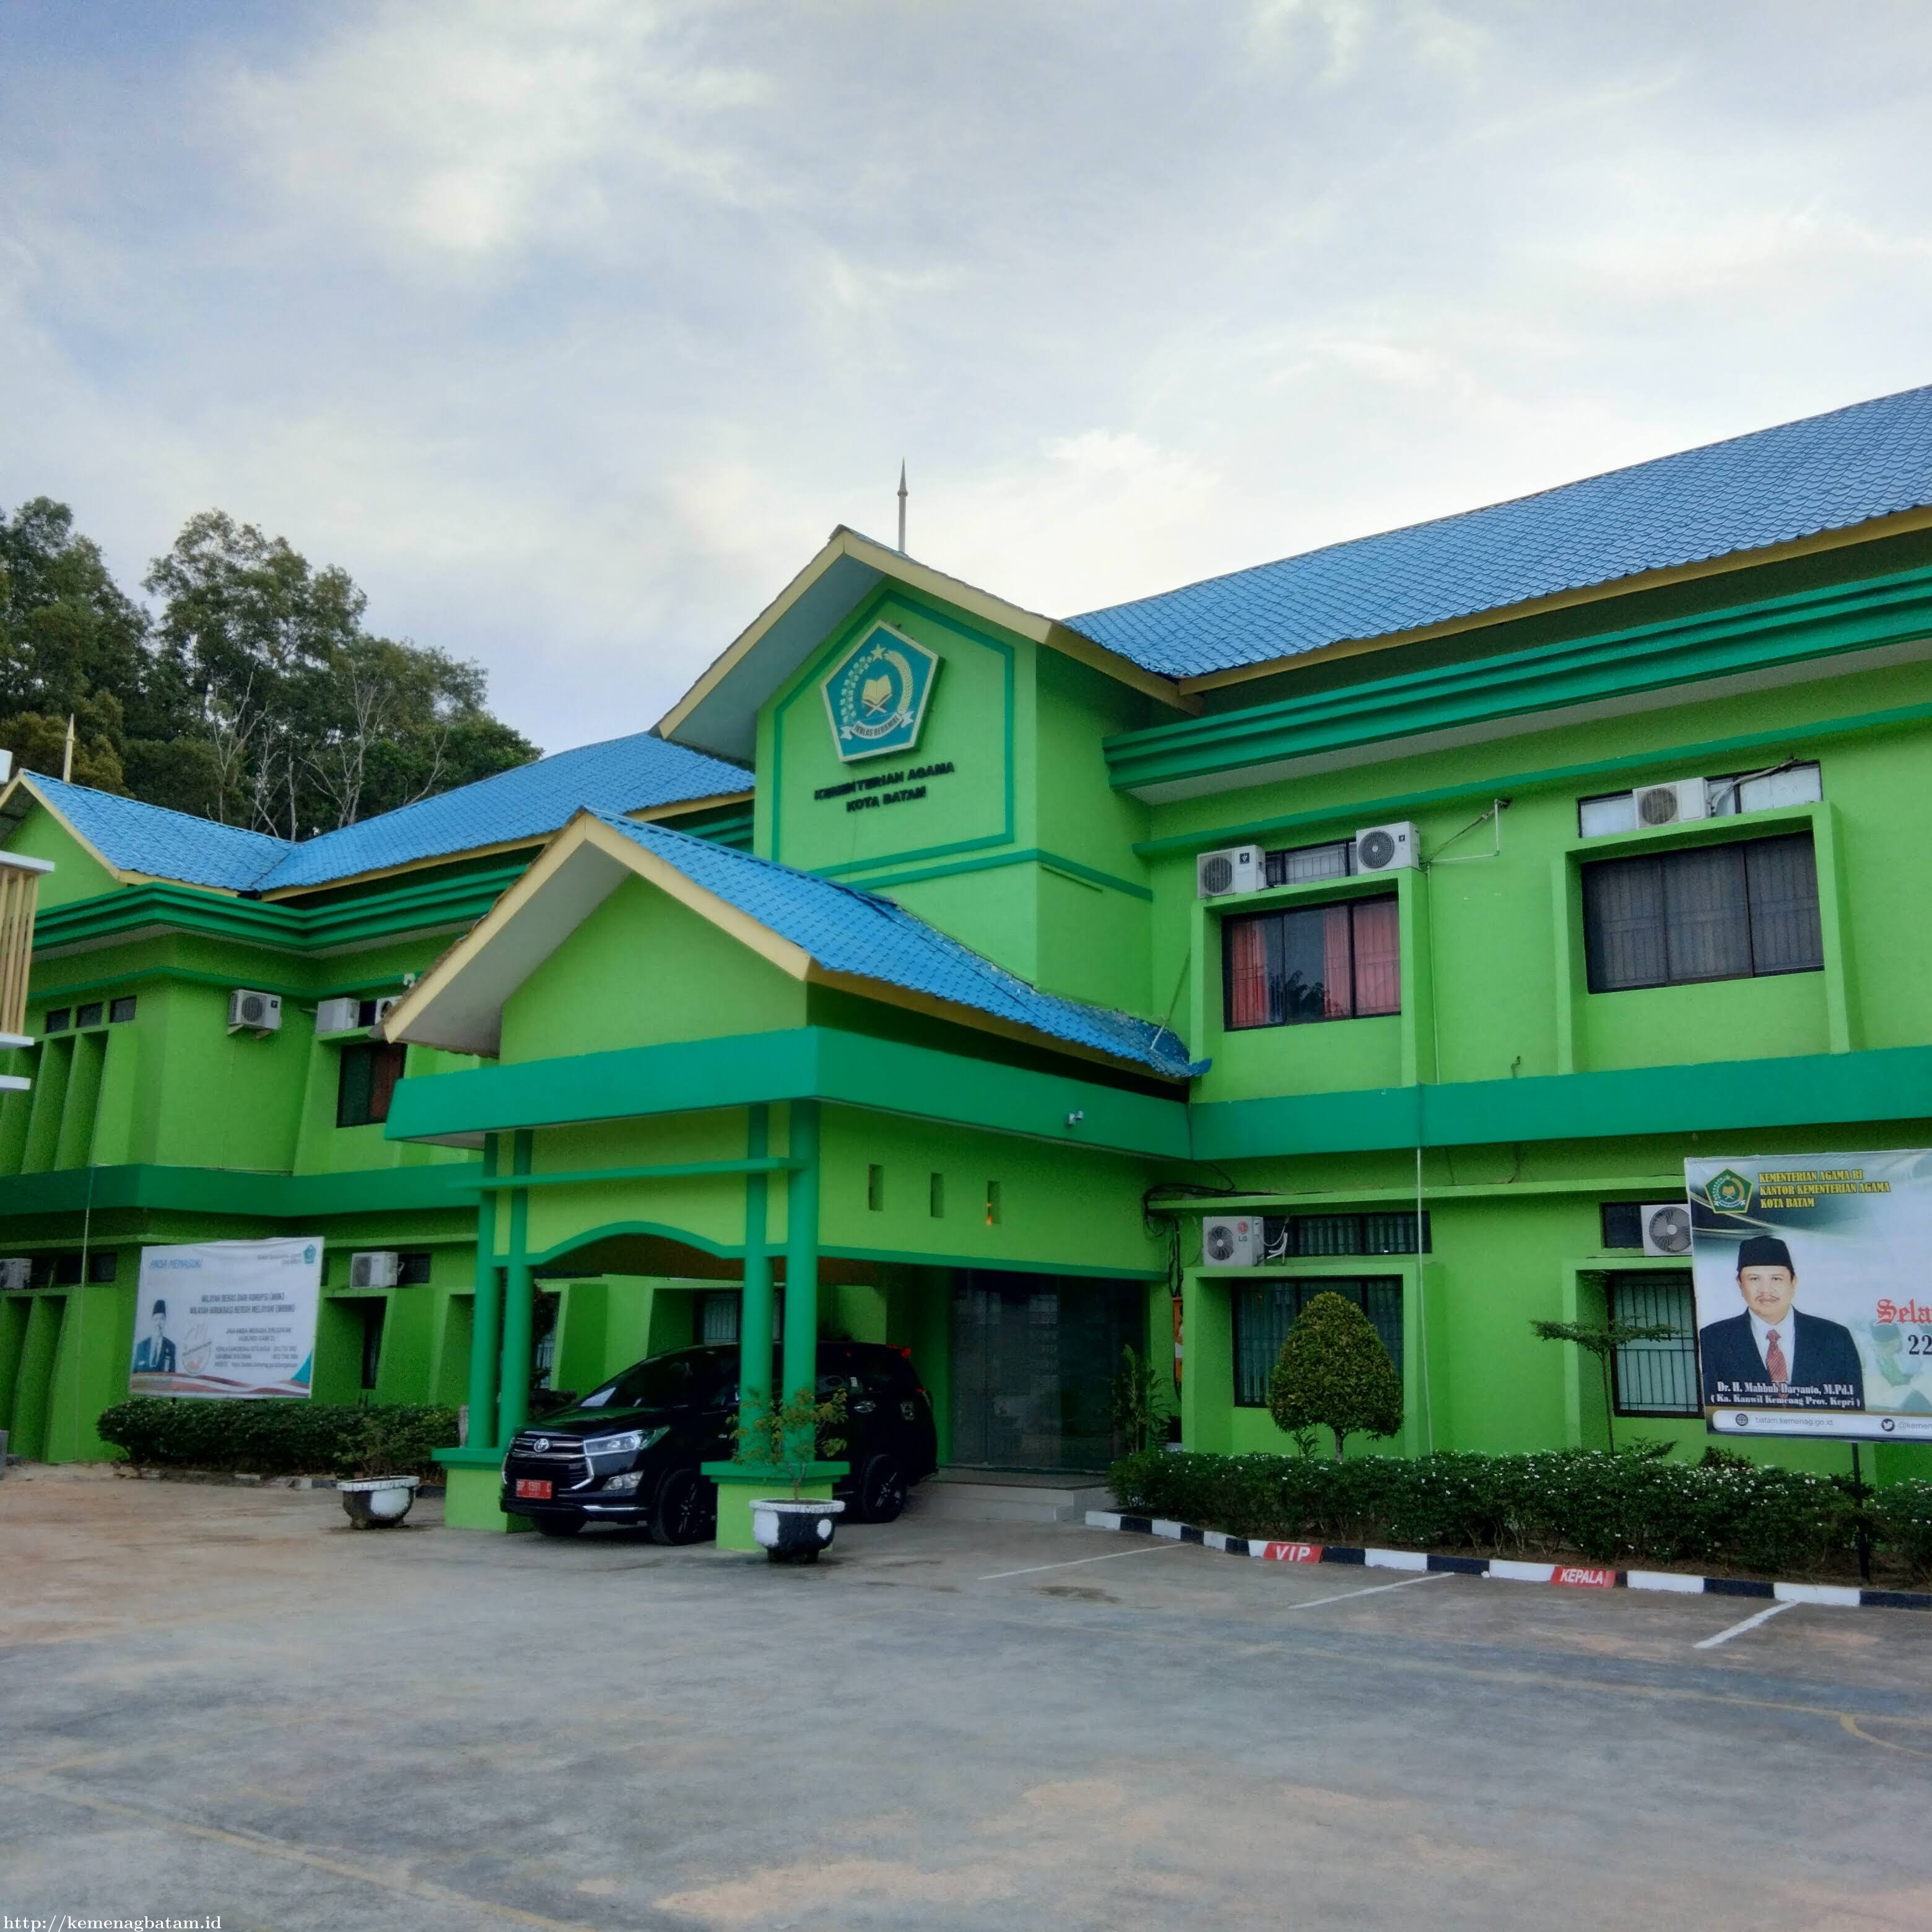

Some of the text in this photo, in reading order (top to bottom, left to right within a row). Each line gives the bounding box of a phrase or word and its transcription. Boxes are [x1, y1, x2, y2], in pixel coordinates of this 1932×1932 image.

[814, 762, 955, 800] KEMENTERIAN AGAMA
[846, 785, 926, 812] KOTA BATAM
[1759, 1169, 1863, 1183] KEMENTERIAN AGAMA RI
[1759, 1181, 1891, 1196] KANTOR KEMENTERIAN AGAMA
[1760, 1197, 1815, 1209] KOTA BATAM
[1908, 1334, 1932, 1355] 22
[1717, 1381, 1731, 1392] Dr.
[1732, 1382, 1743, 1392] H.
[1744, 1382, 1778, 1393] Mahbub
[1780, 1383, 1822, 1396] Daryanto,
[1717, 1394, 1731, 1403] Ka.
[1733, 1395, 1763, 1403] Kanwil
[1765, 1395, 1804, 1406] Kemenag
[1830, 1397, 1854, 1408] Kepri
[1276, 1545, 1311, 1561] VIP
[1560, 1568, 1604, 1585] KEPALA
